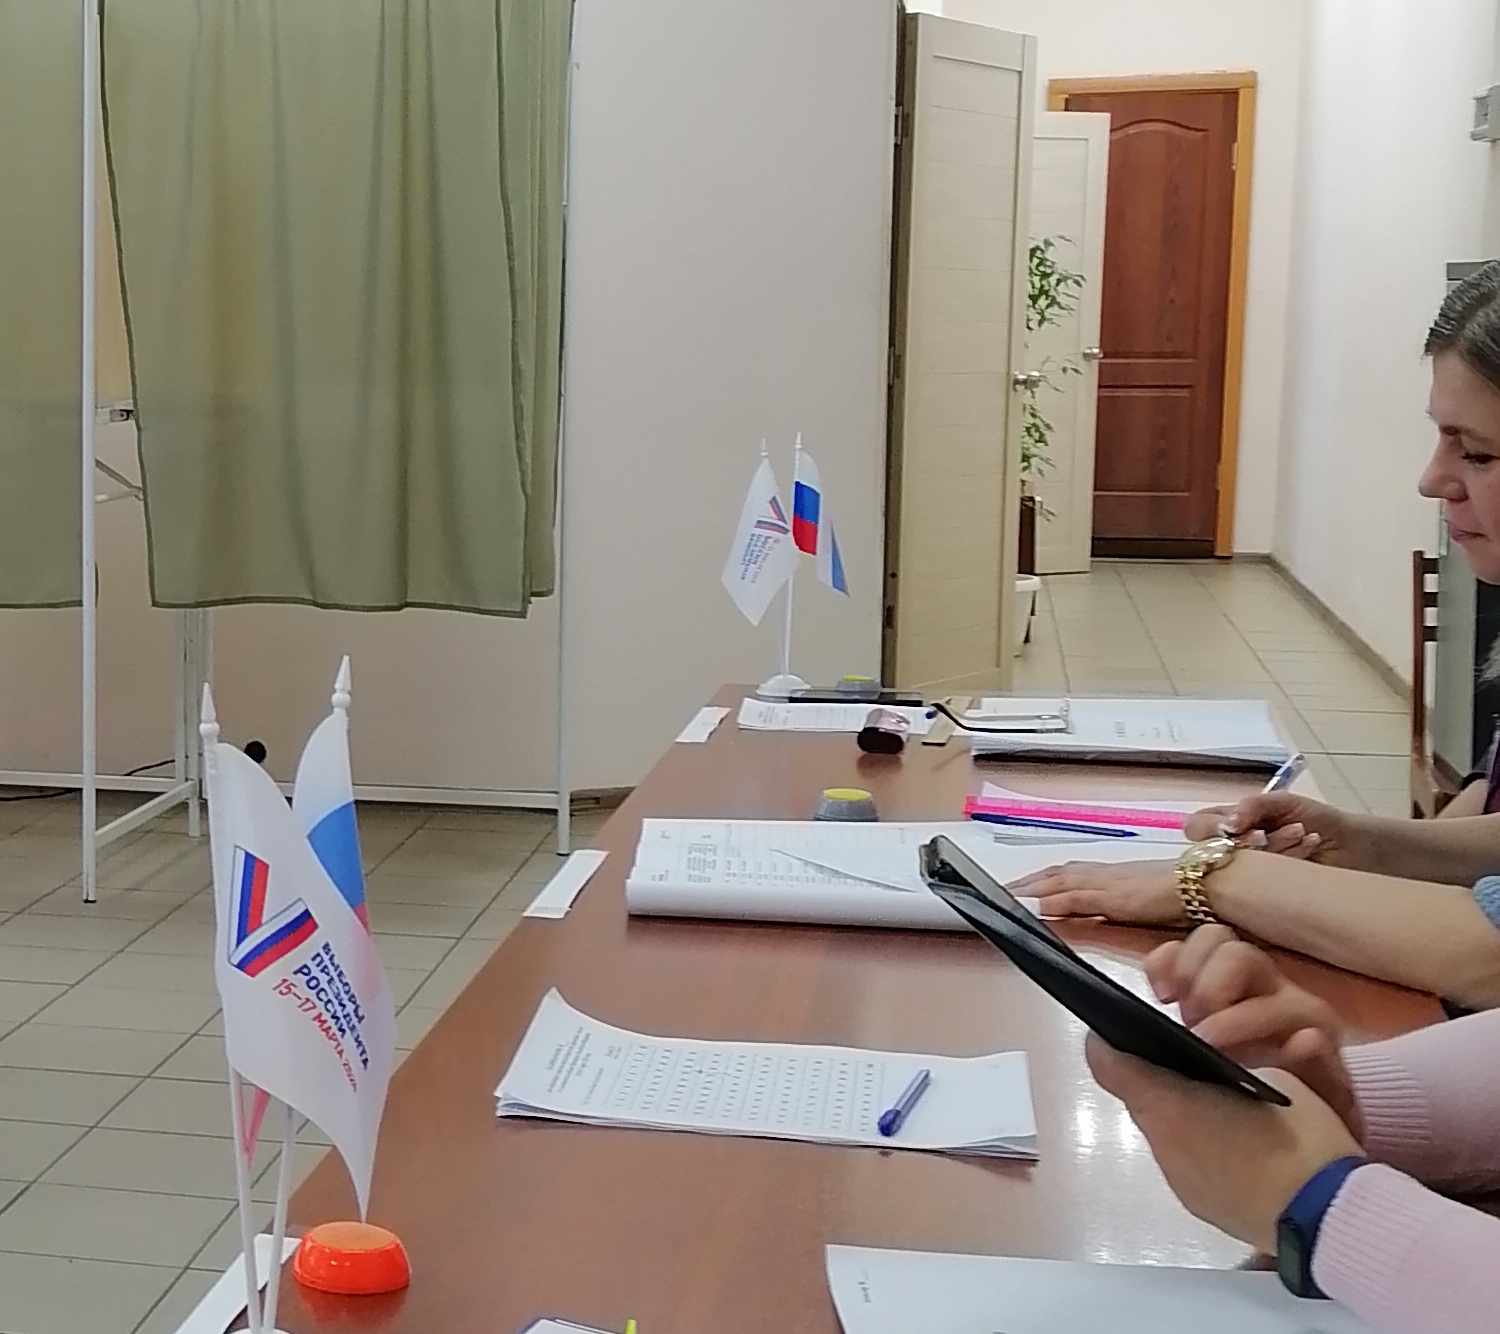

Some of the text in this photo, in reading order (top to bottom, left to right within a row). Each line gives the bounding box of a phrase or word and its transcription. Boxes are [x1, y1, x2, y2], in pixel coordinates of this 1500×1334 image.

[293, 963, 347, 1039] РОССИИ
[311, 952, 369, 1071] ПРЕЗИДЕНТА
[321, 940, 366, 1024] ВЫБОРЫ
